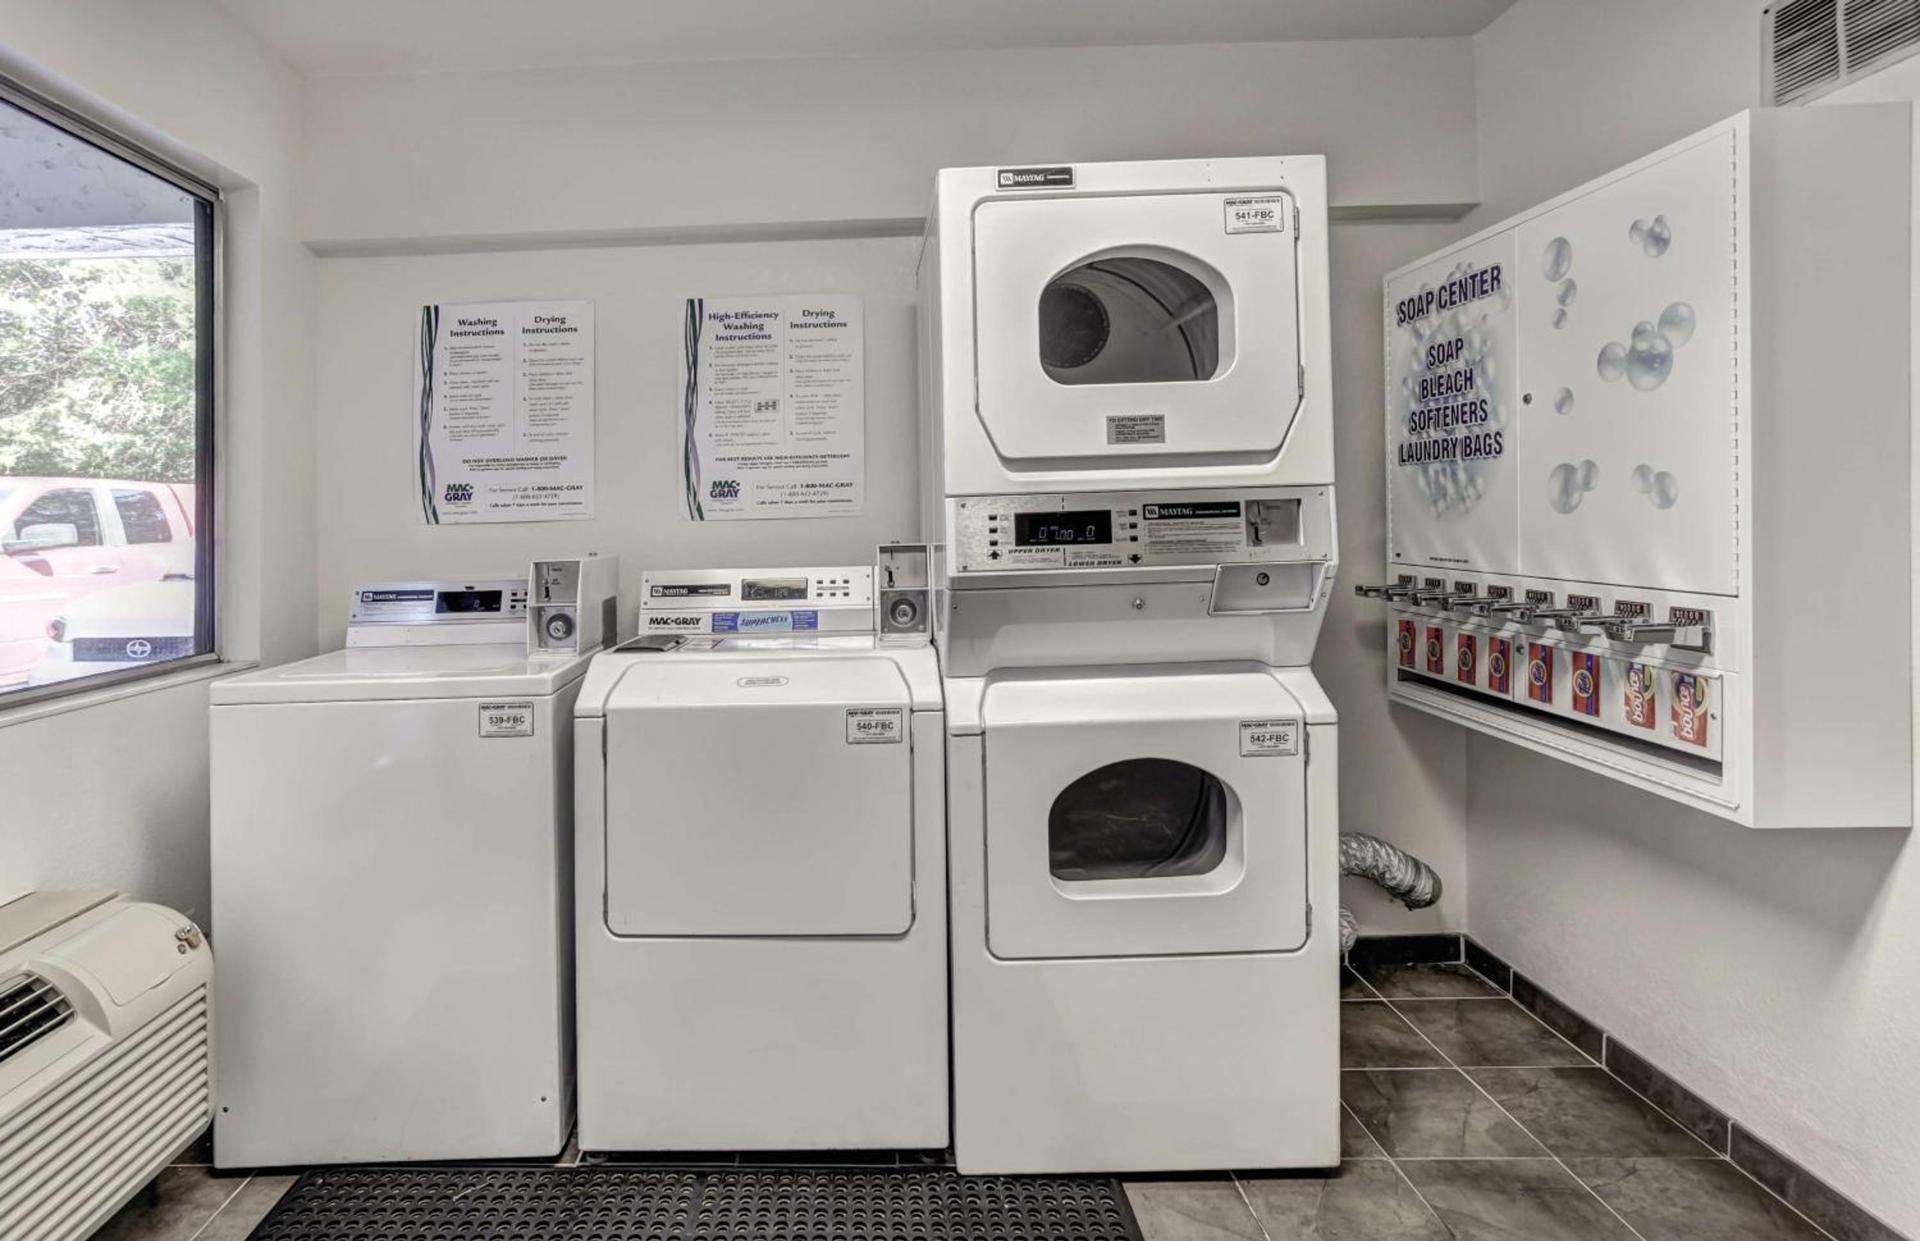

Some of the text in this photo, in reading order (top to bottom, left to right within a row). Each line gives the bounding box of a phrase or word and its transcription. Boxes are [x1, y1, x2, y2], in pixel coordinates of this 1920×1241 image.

[1235, 210, 1275, 220] 541-FBC
[1397, 264, 1502, 326] SOAP CENTER
[708, 310, 779, 322] High-Efficiency
[802, 308, 836, 319] Drying
[457, 318, 498, 328] Washing
[534, 315, 567, 326] Drying
[790, 320, 848, 329] Instructions
[522, 325, 578, 334] Instructions
[723, 321, 765, 331] Washing
[449, 327, 505, 337] Instructions
[715, 332, 772, 341] Instructions
[1428, 337, 1464, 368] SOAP
[1420, 368, 1474, 401] BLEACH
[1409, 399, 1489, 433] SOFTENERS
[1399, 431, 1504, 466] LAUNDRY BAGS
[447, 483, 471, 492] MAC
[712, 480, 737, 489] MAC
[444, 492, 474, 502] GRAY
[709, 488, 740, 498] GRAY
[1160, 507, 1193, 516] MAYTAG
[1628, 670, 1644, 722] bounce
[1679, 684, 1696, 738] bounce
[856, 722, 894, 730] 540-FBC
[1250, 734, 1289, 743] 542-FBC
